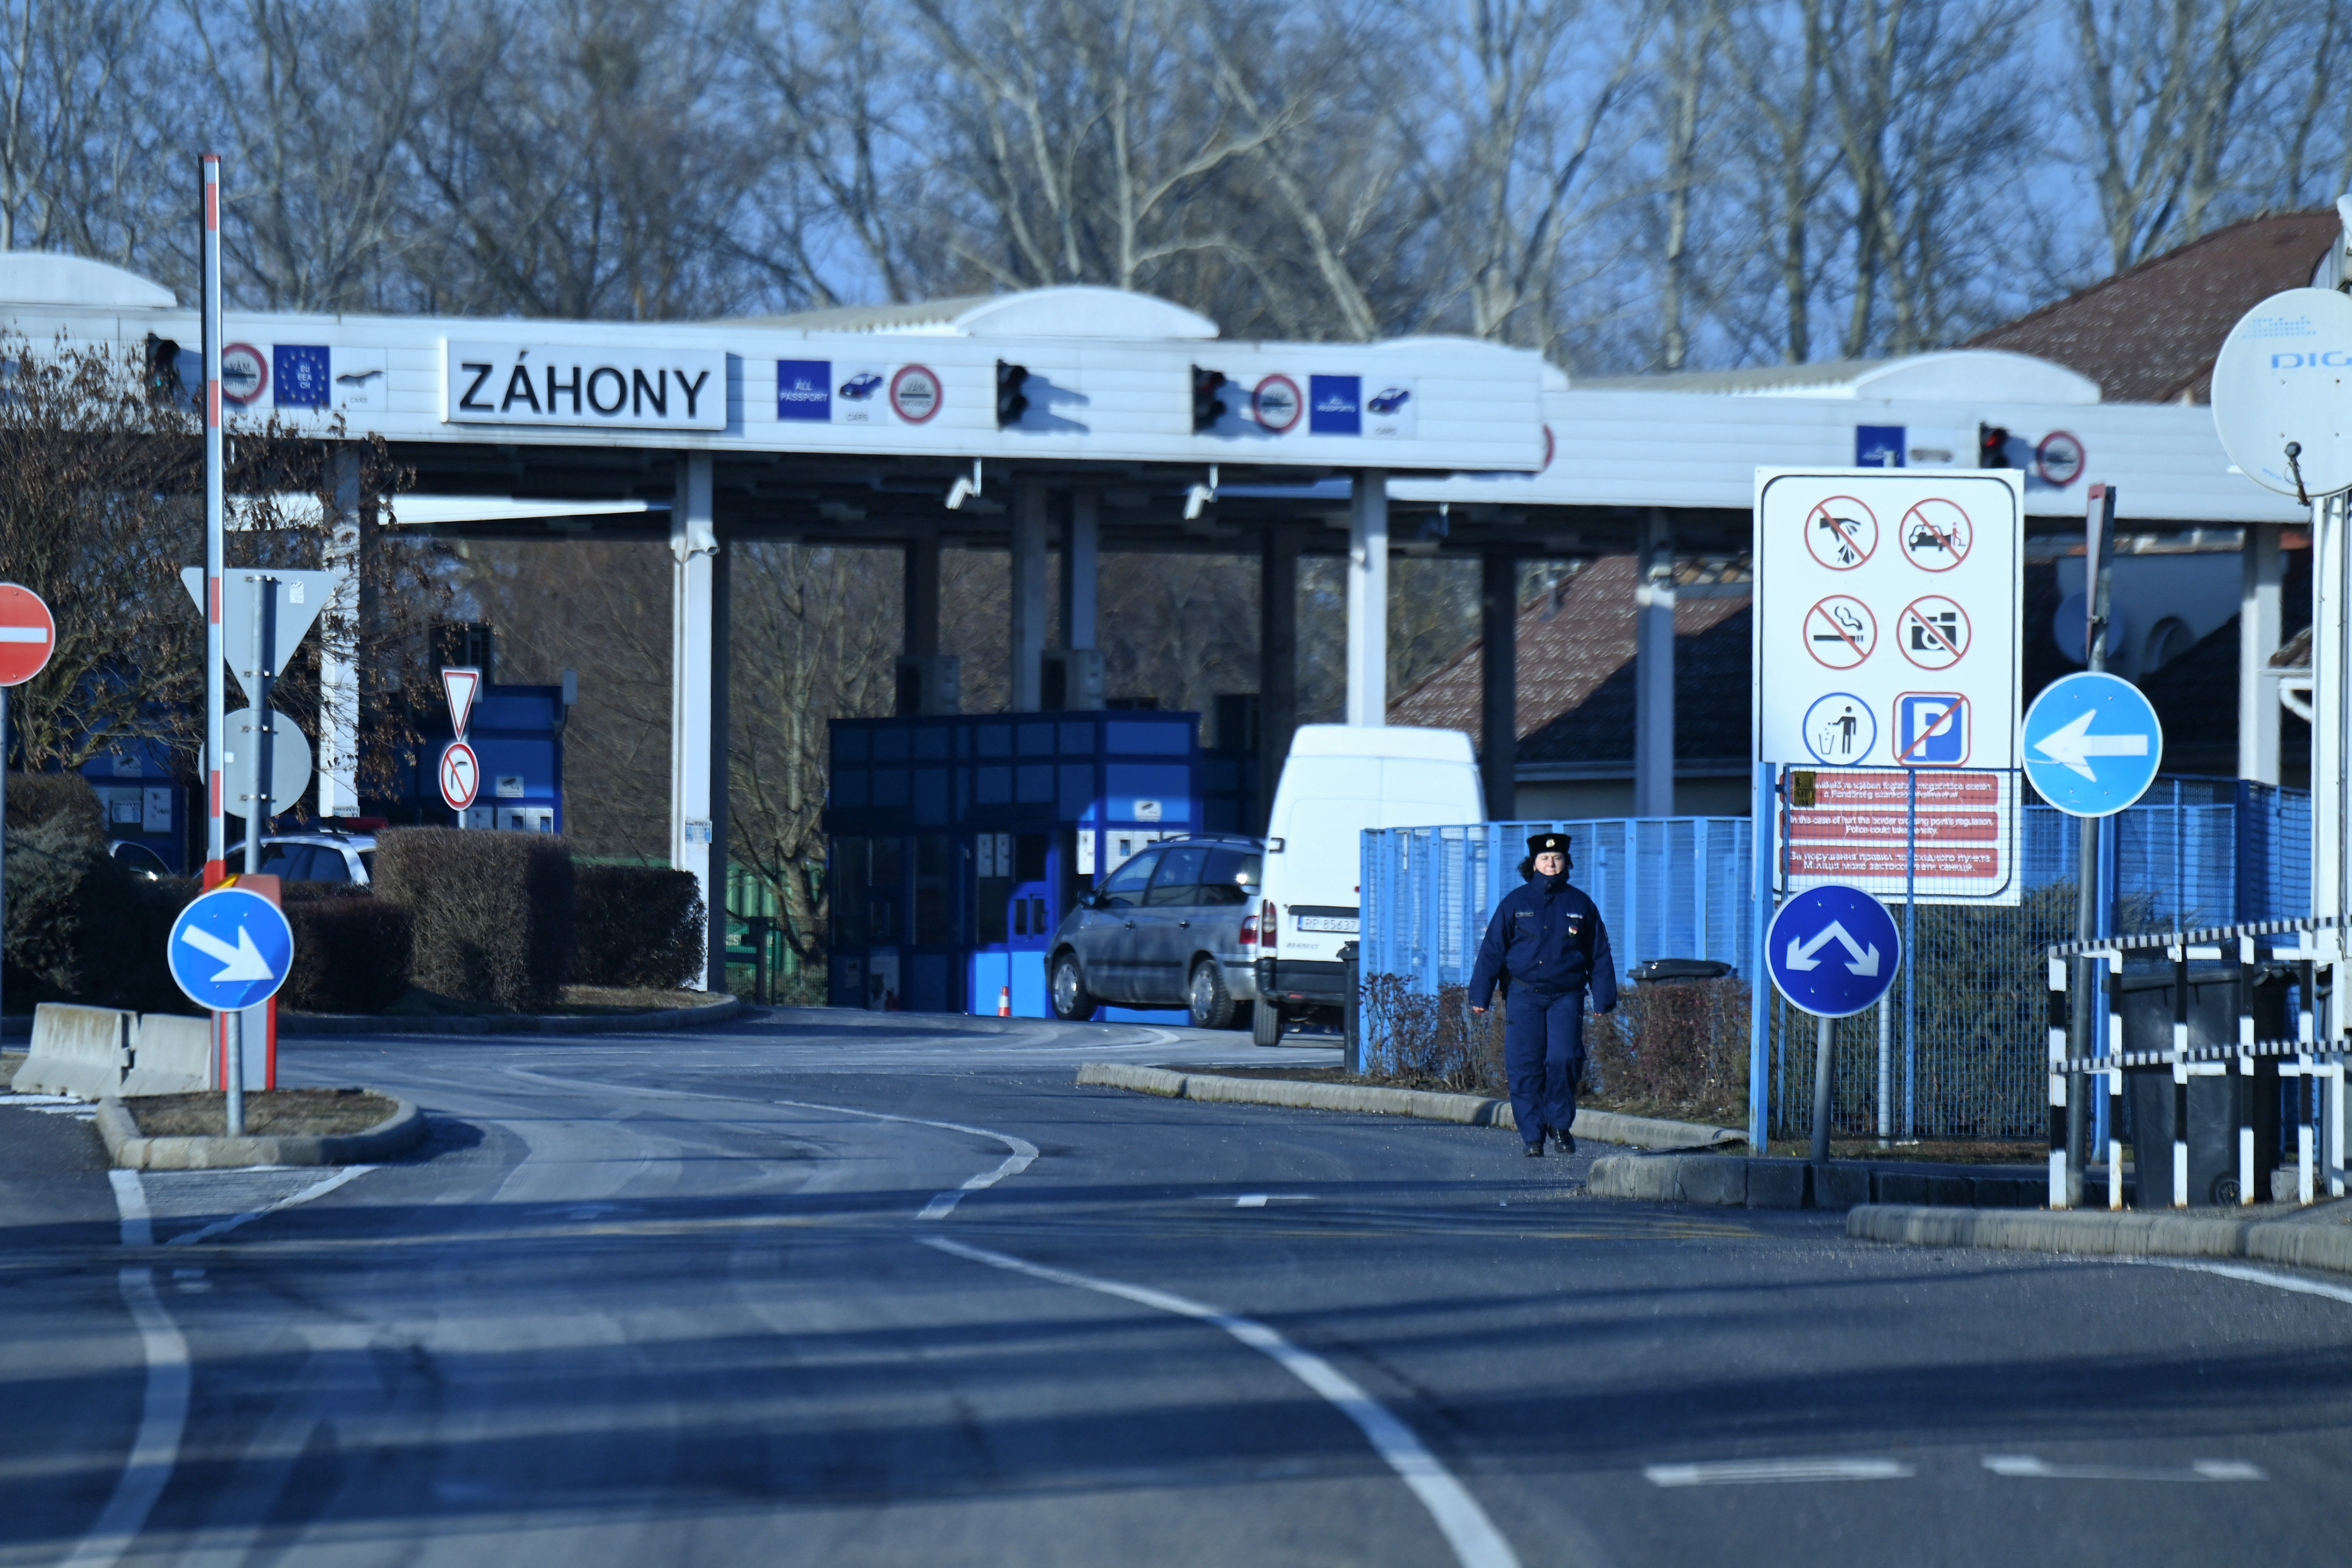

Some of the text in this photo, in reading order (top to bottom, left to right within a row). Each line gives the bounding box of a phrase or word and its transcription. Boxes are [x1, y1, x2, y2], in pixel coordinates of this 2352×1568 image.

[459, 350, 711, 419] ZÁHONY
[847, 414, 869, 422] CARS
[1799, 815, 1811, 824] the
[1832, 815, 1841, 825] of
[1858, 815, 1870, 825] the
[1846, 825, 1868, 833] Police
[1870, 825, 1891, 834] could
[1305, 918, 1319, 929] RP
[1323, 919, 1356, 930] 85637
